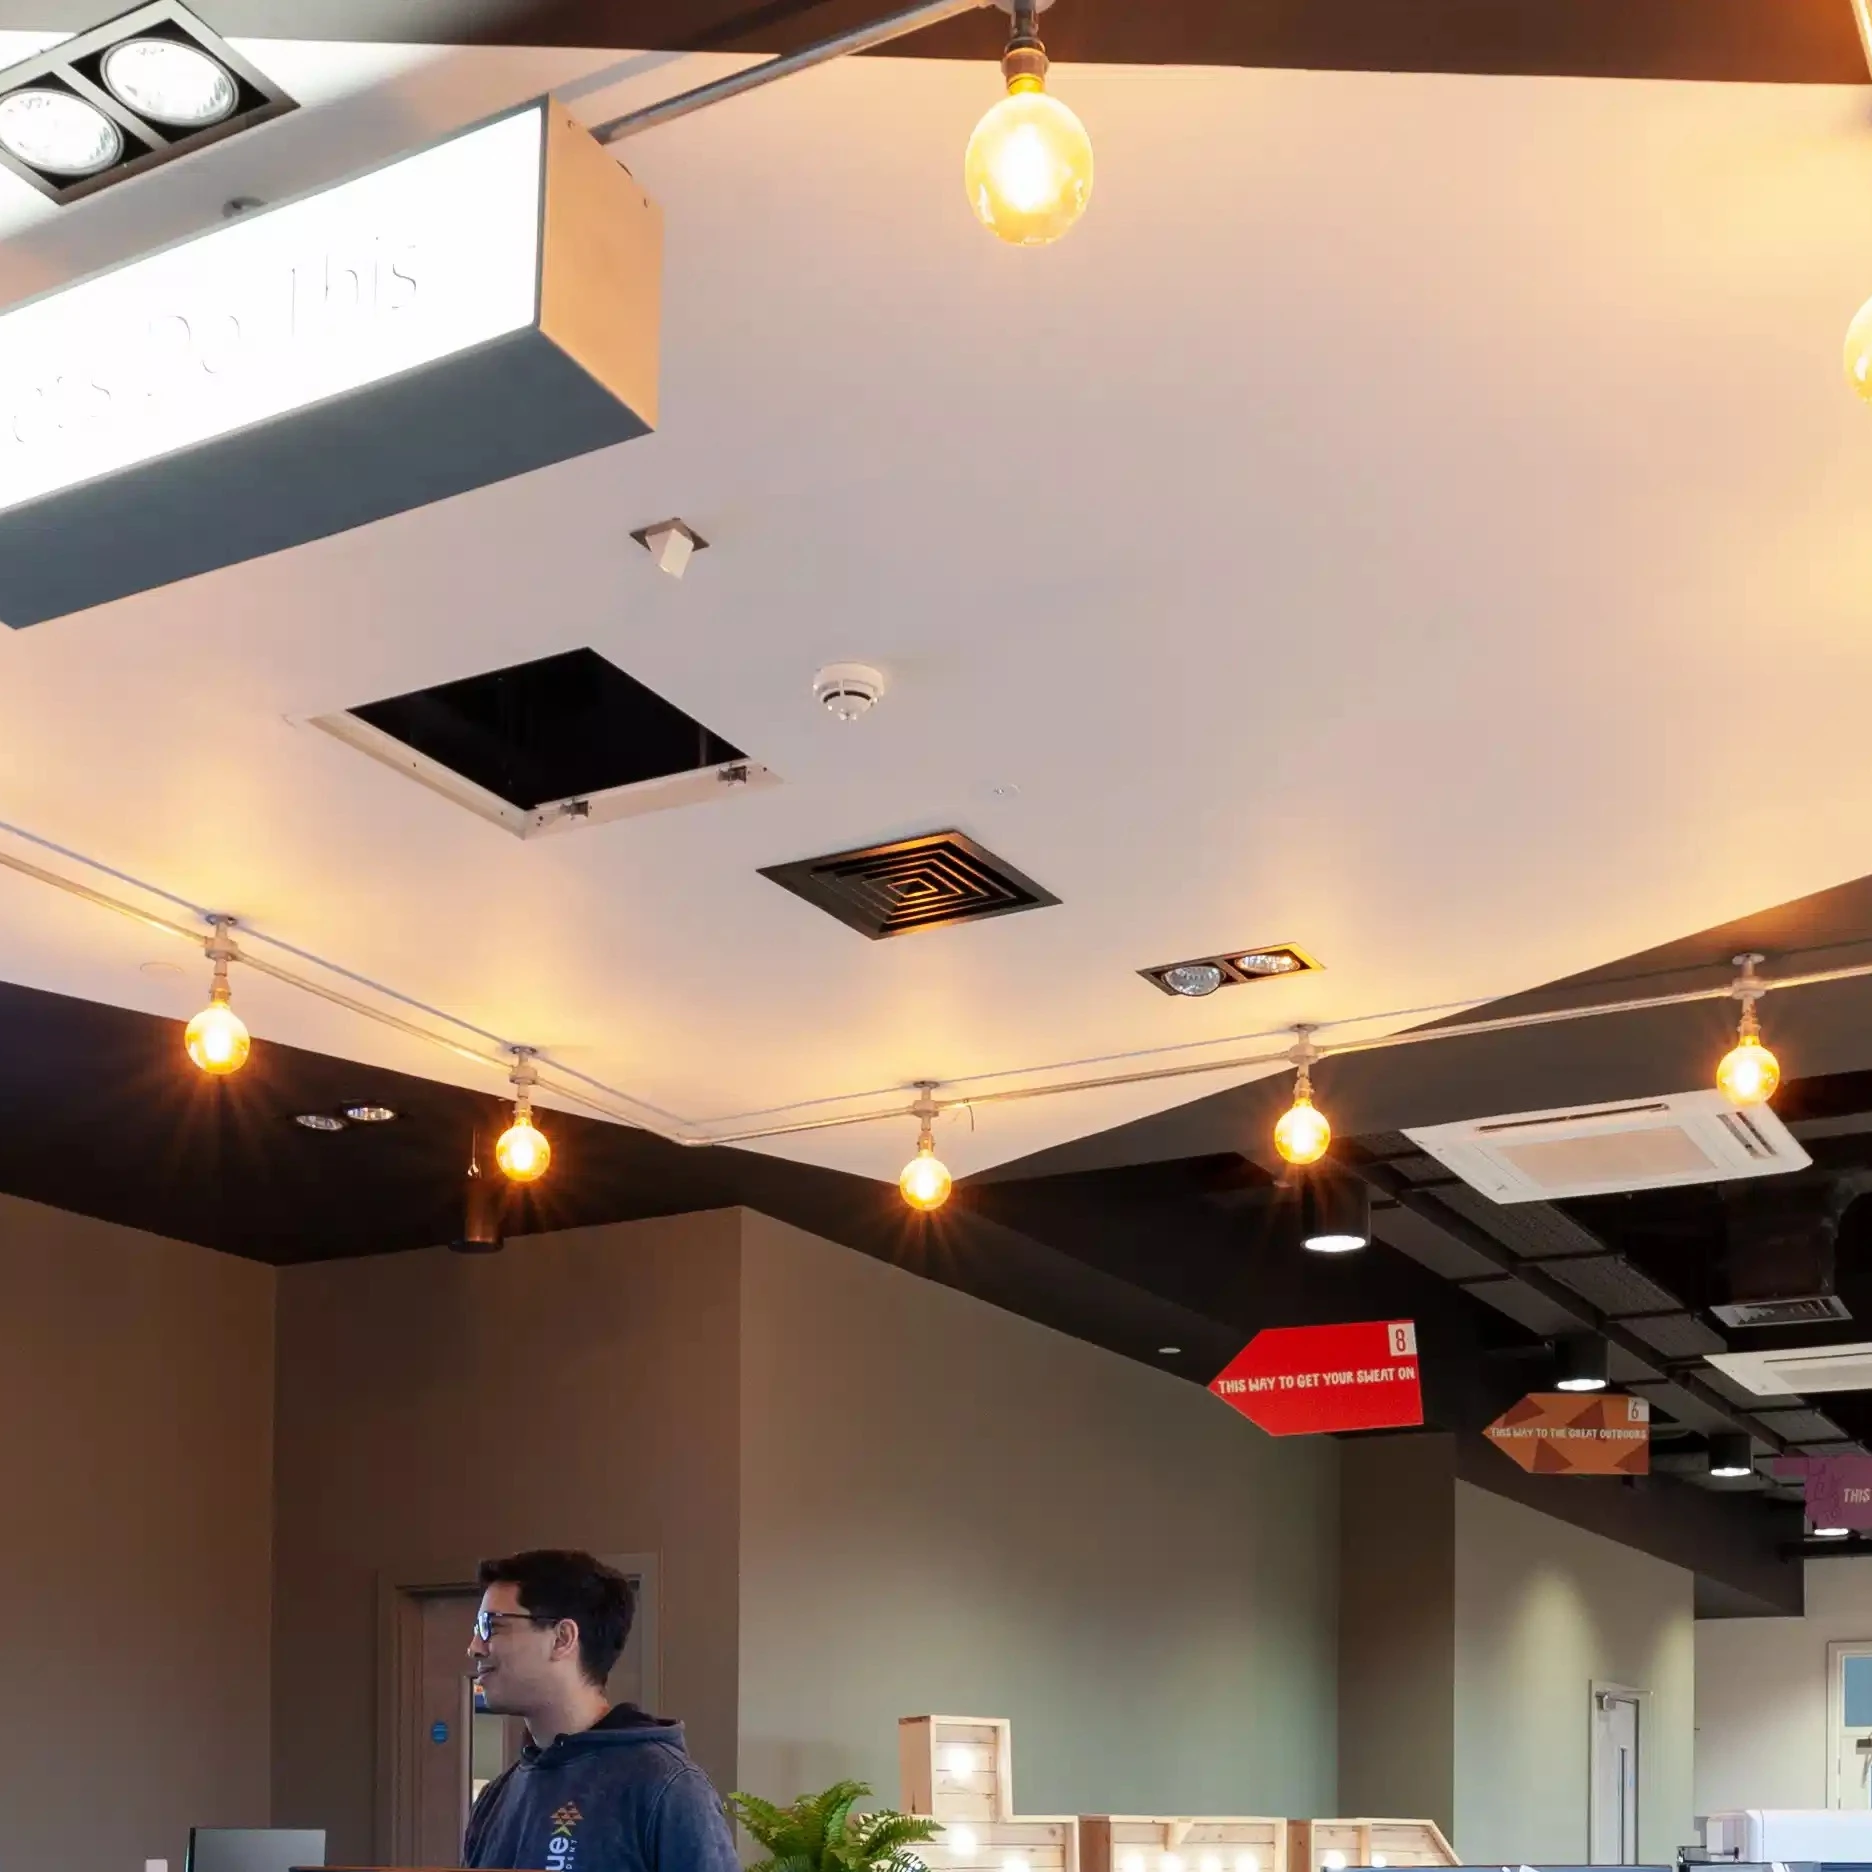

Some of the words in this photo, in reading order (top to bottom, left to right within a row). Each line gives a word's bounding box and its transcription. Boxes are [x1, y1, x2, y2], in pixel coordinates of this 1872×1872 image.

[1395, 1328, 1406, 1352] 8
[1218, 1380, 1246, 1394] THIS
[1248, 1376, 1276, 1392] WAY
[1278, 1375, 1293, 1390] TO
[1297, 1374, 1319, 1388] GET
[1323, 1371, 1353, 1386] YOUR
[1357, 1368, 1394, 1383] SWEAT
[1398, 1366, 1416, 1380] ON
[1630, 1401, 1639, 1420] 6
[1491, 1427, 1512, 1438] THIS
[1513, 1428, 1534, 1438] WAY
[1535, 1428, 1548, 1438] TO
[1550, 1428, 1566, 1438] THE
[1568, 1427, 1597, 1439] GREAT
[1599, 1428, 1646, 1440] OUTDOORS
[1843, 1488, 1870, 1503] THIS
